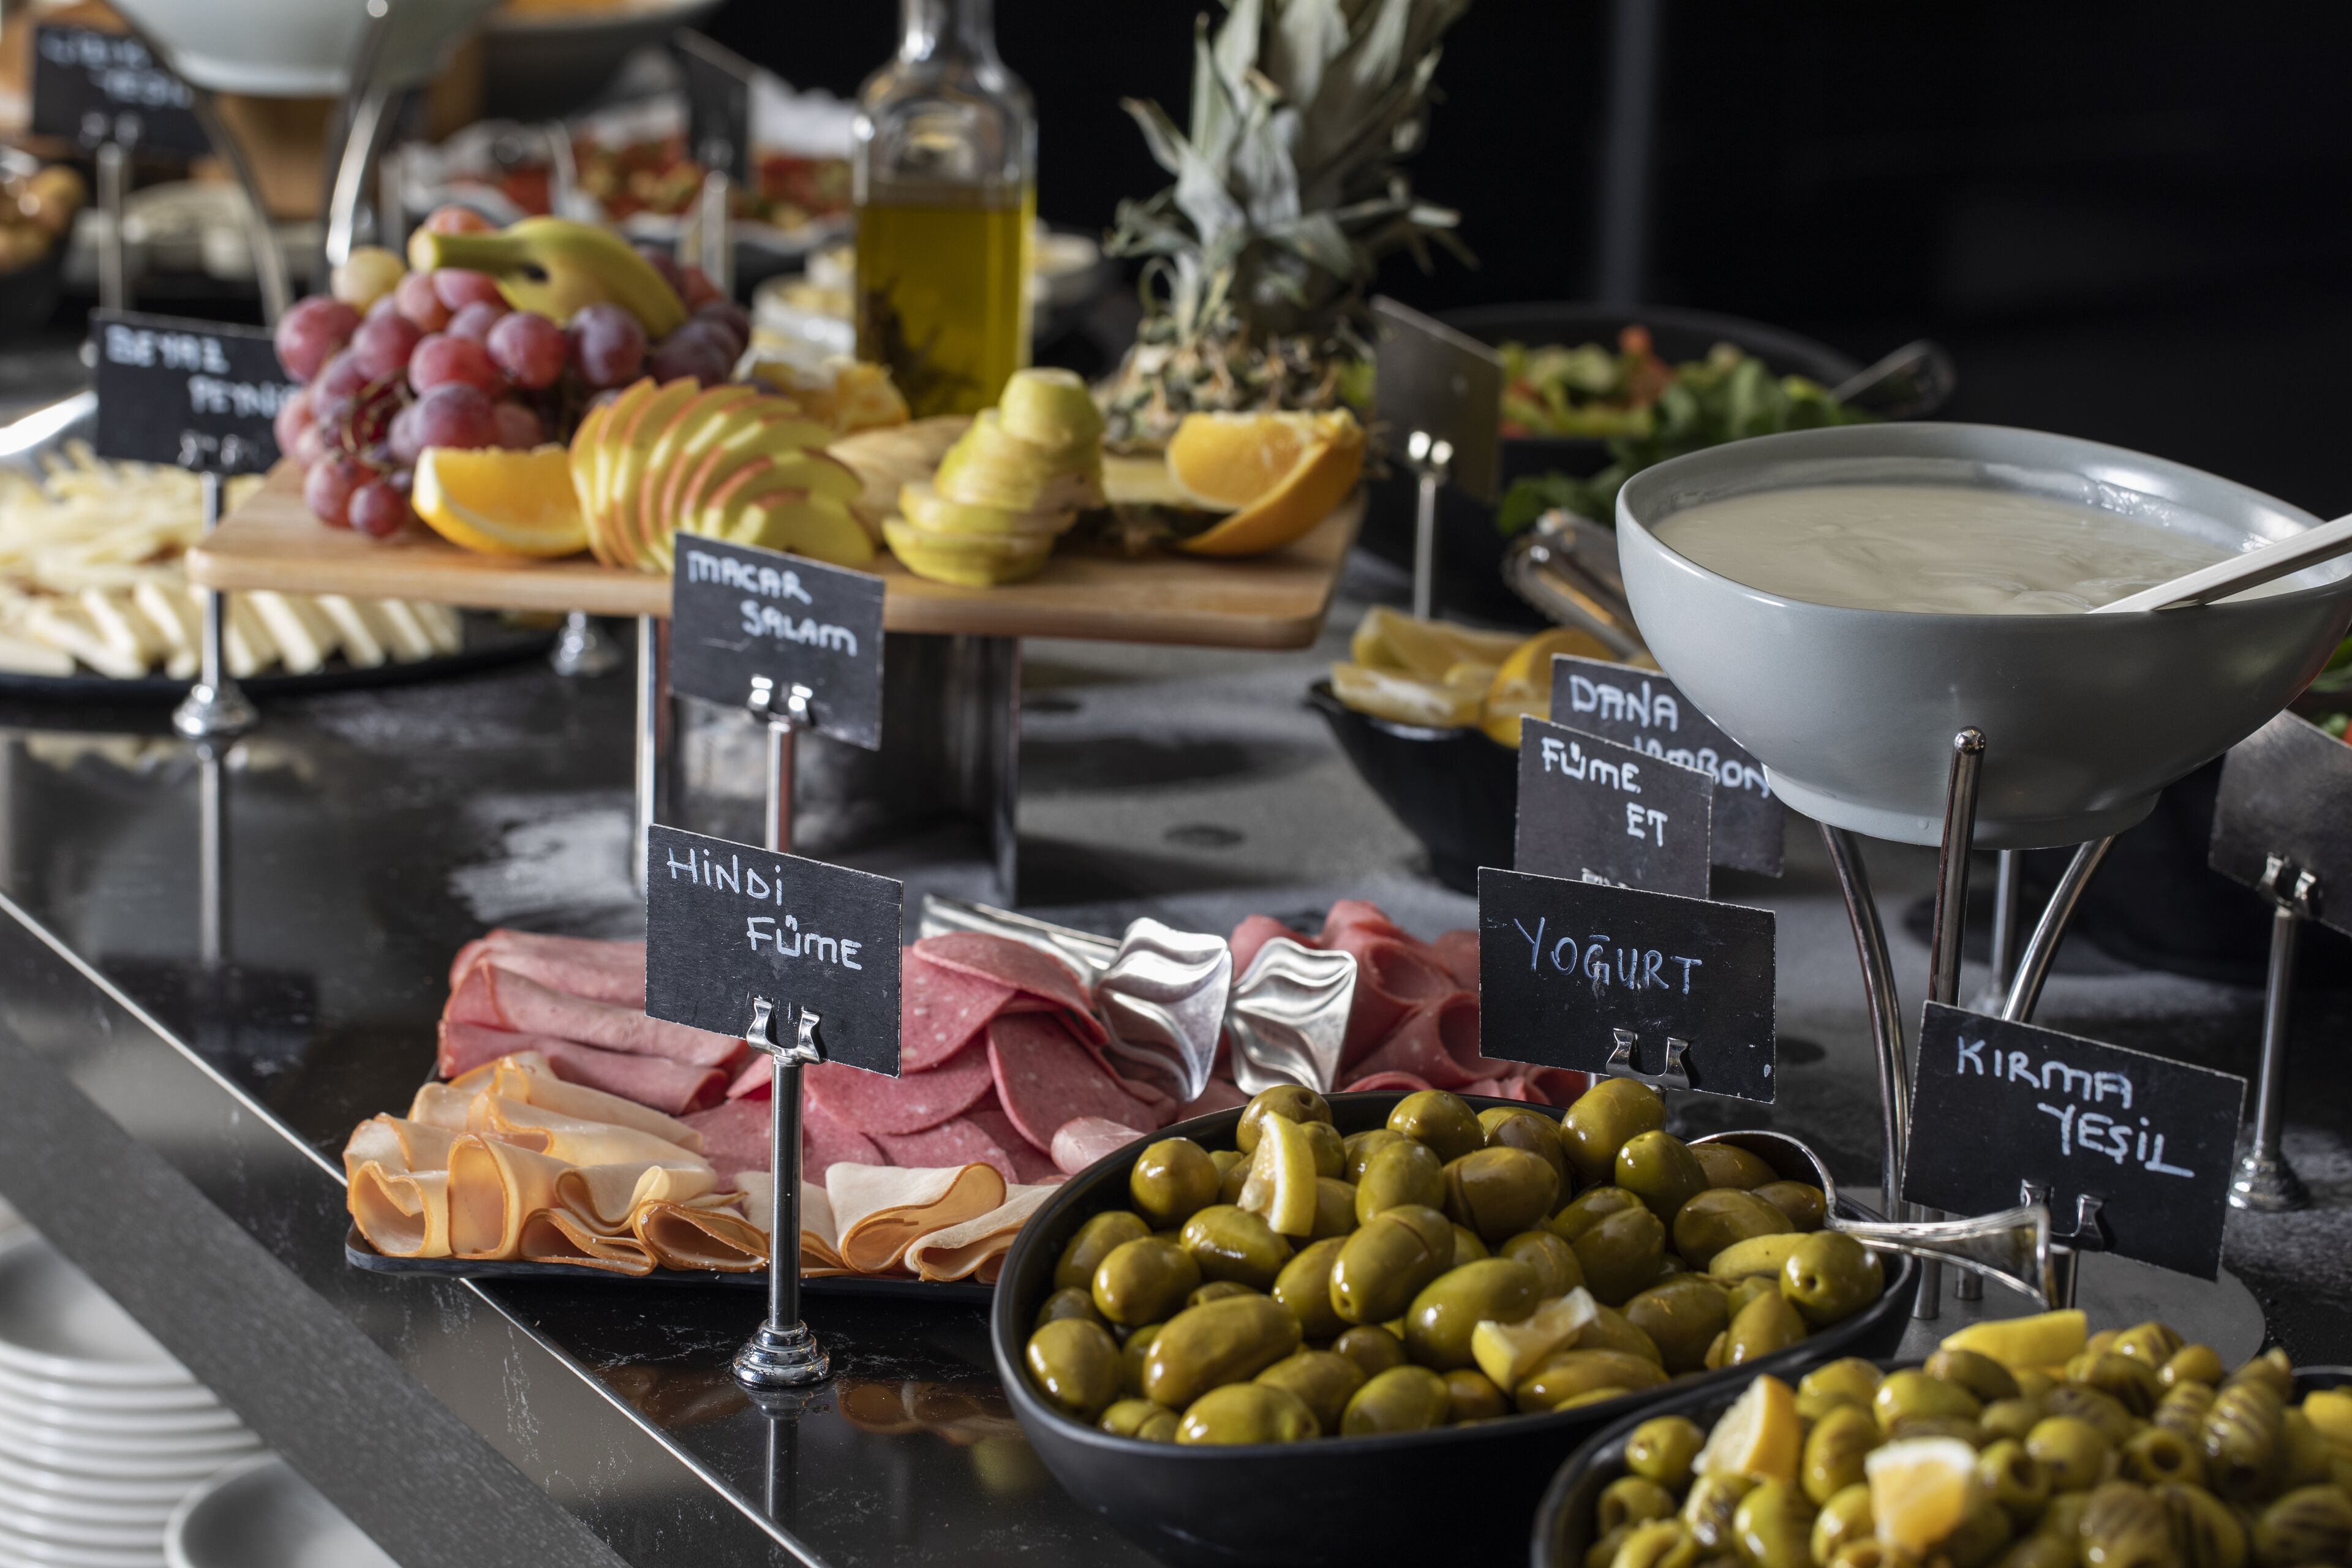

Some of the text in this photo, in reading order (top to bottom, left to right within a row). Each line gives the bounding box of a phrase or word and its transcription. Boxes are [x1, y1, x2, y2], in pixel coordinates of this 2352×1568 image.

[687, 550, 812, 605] MACAR
[740, 600, 858, 657] SALAM
[1569, 674, 1678, 732] DANA
[1541, 737, 1641, 794] FÜME
[1626, 801, 1668, 847] ET
[1513, 917, 1702, 995] YOĞURT
[1957, 1036, 2133, 1110] KIRMA
[2037, 1102, 2195, 1178] YEŞİL
